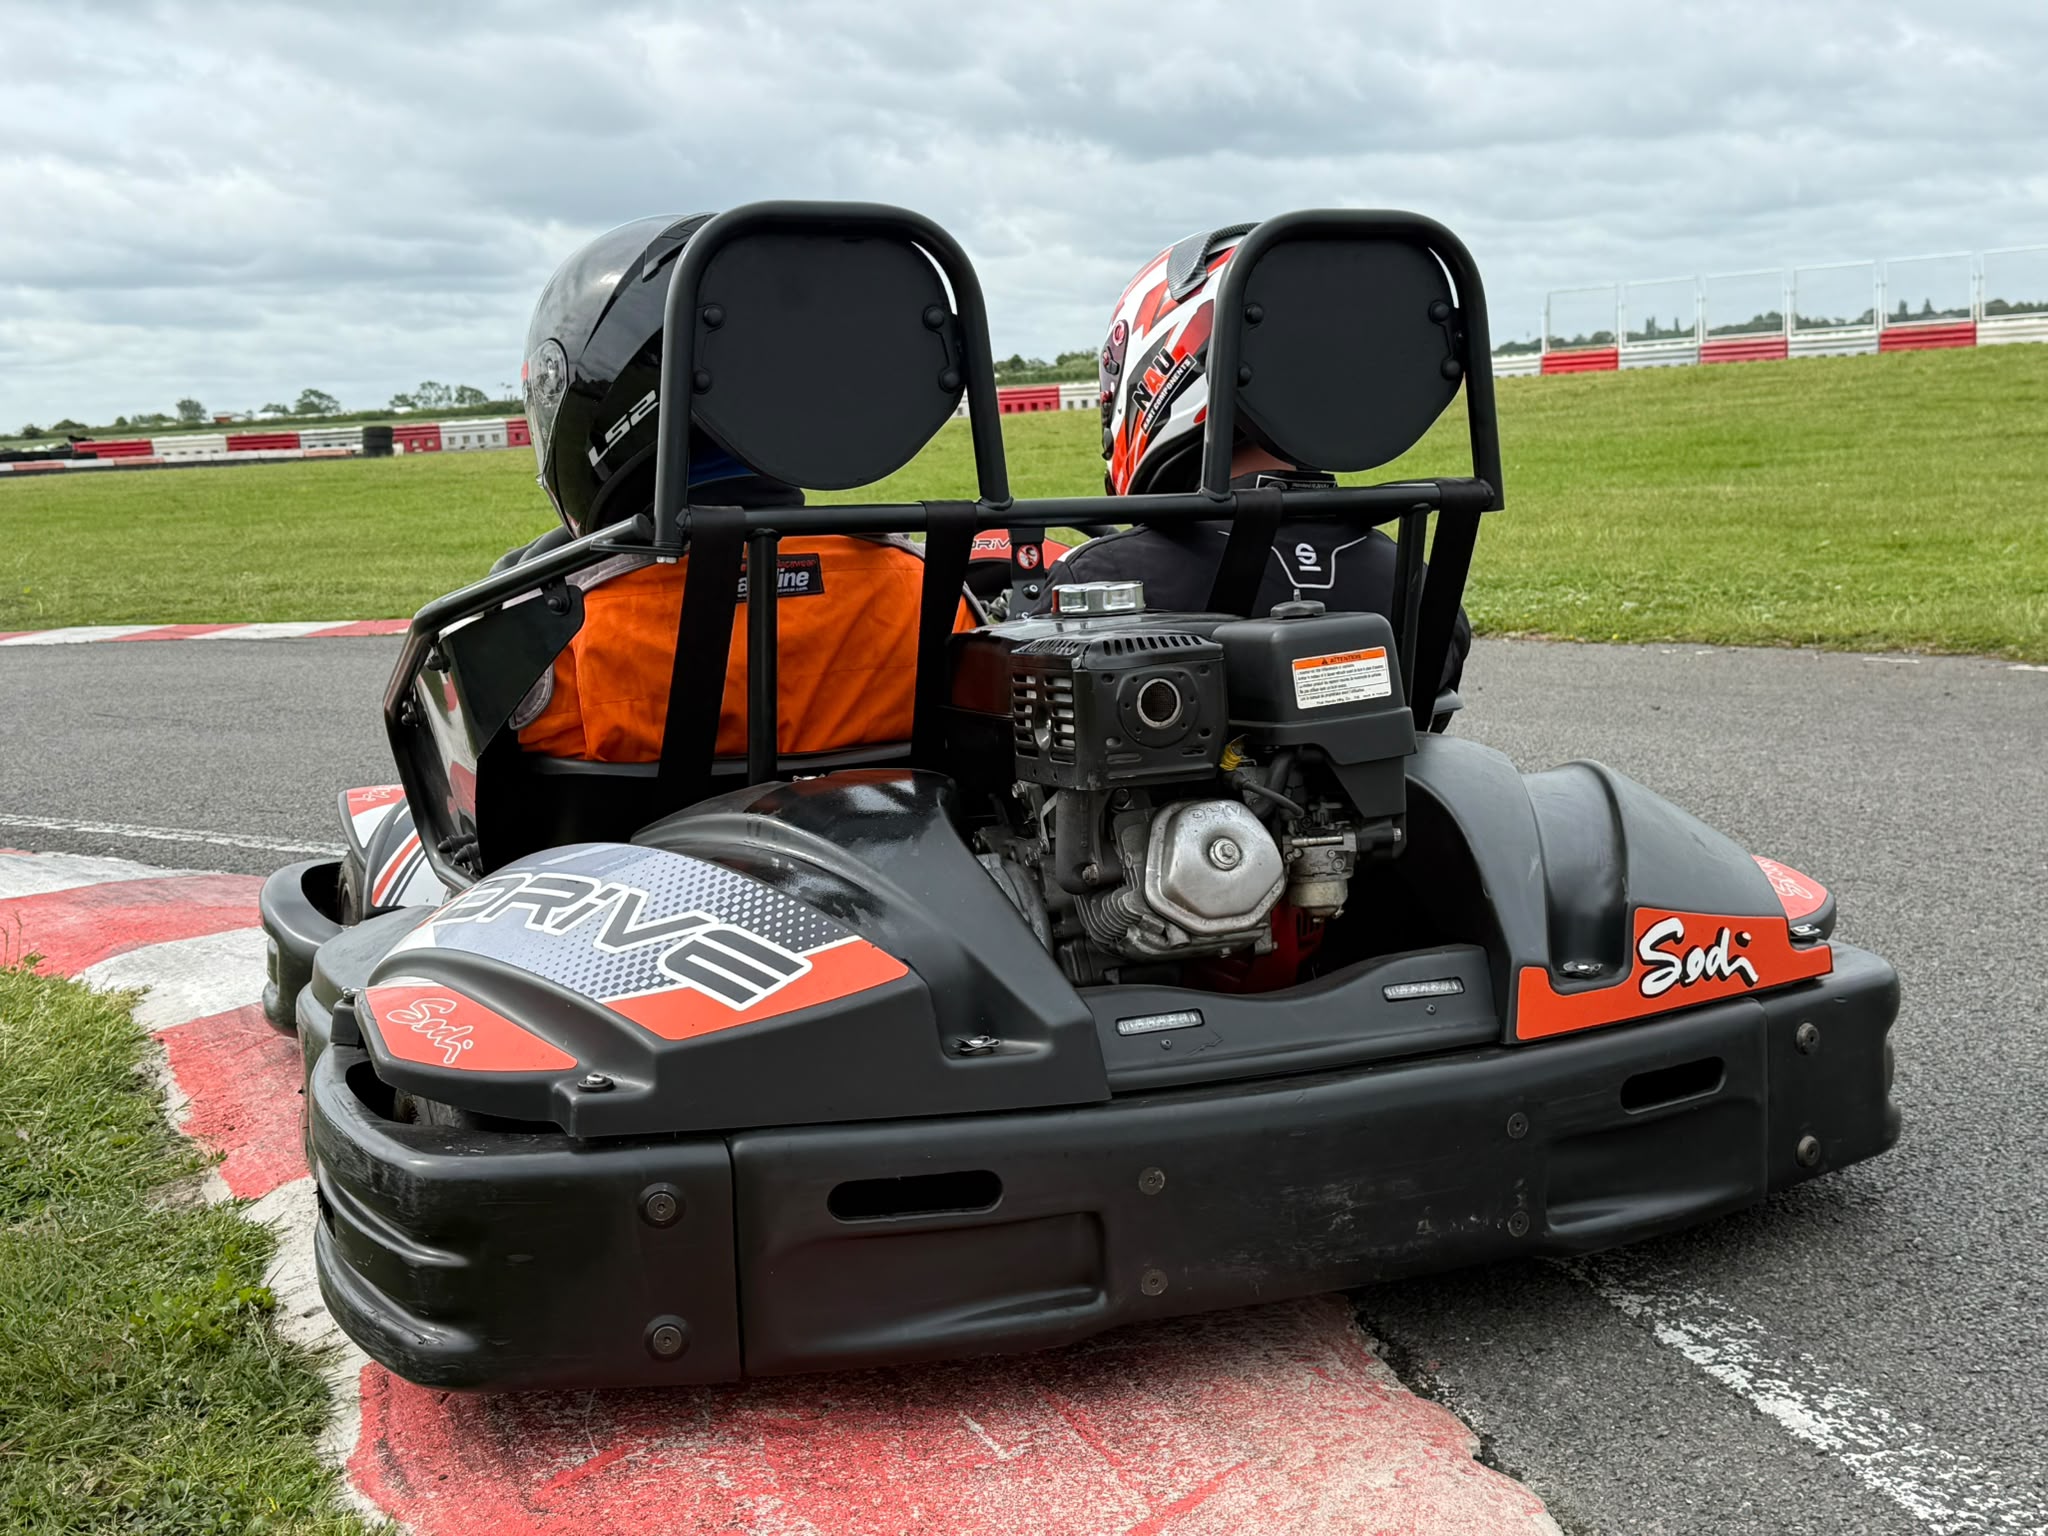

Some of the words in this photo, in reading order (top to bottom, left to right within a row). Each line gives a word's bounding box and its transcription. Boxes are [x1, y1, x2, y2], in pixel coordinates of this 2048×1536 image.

[1132, 347, 1176, 412] NAU
[1154, 358, 1191, 409] COMPONENTS
[588, 390, 659, 467] LS2
[1637, 917, 1759, 998] Sodi
